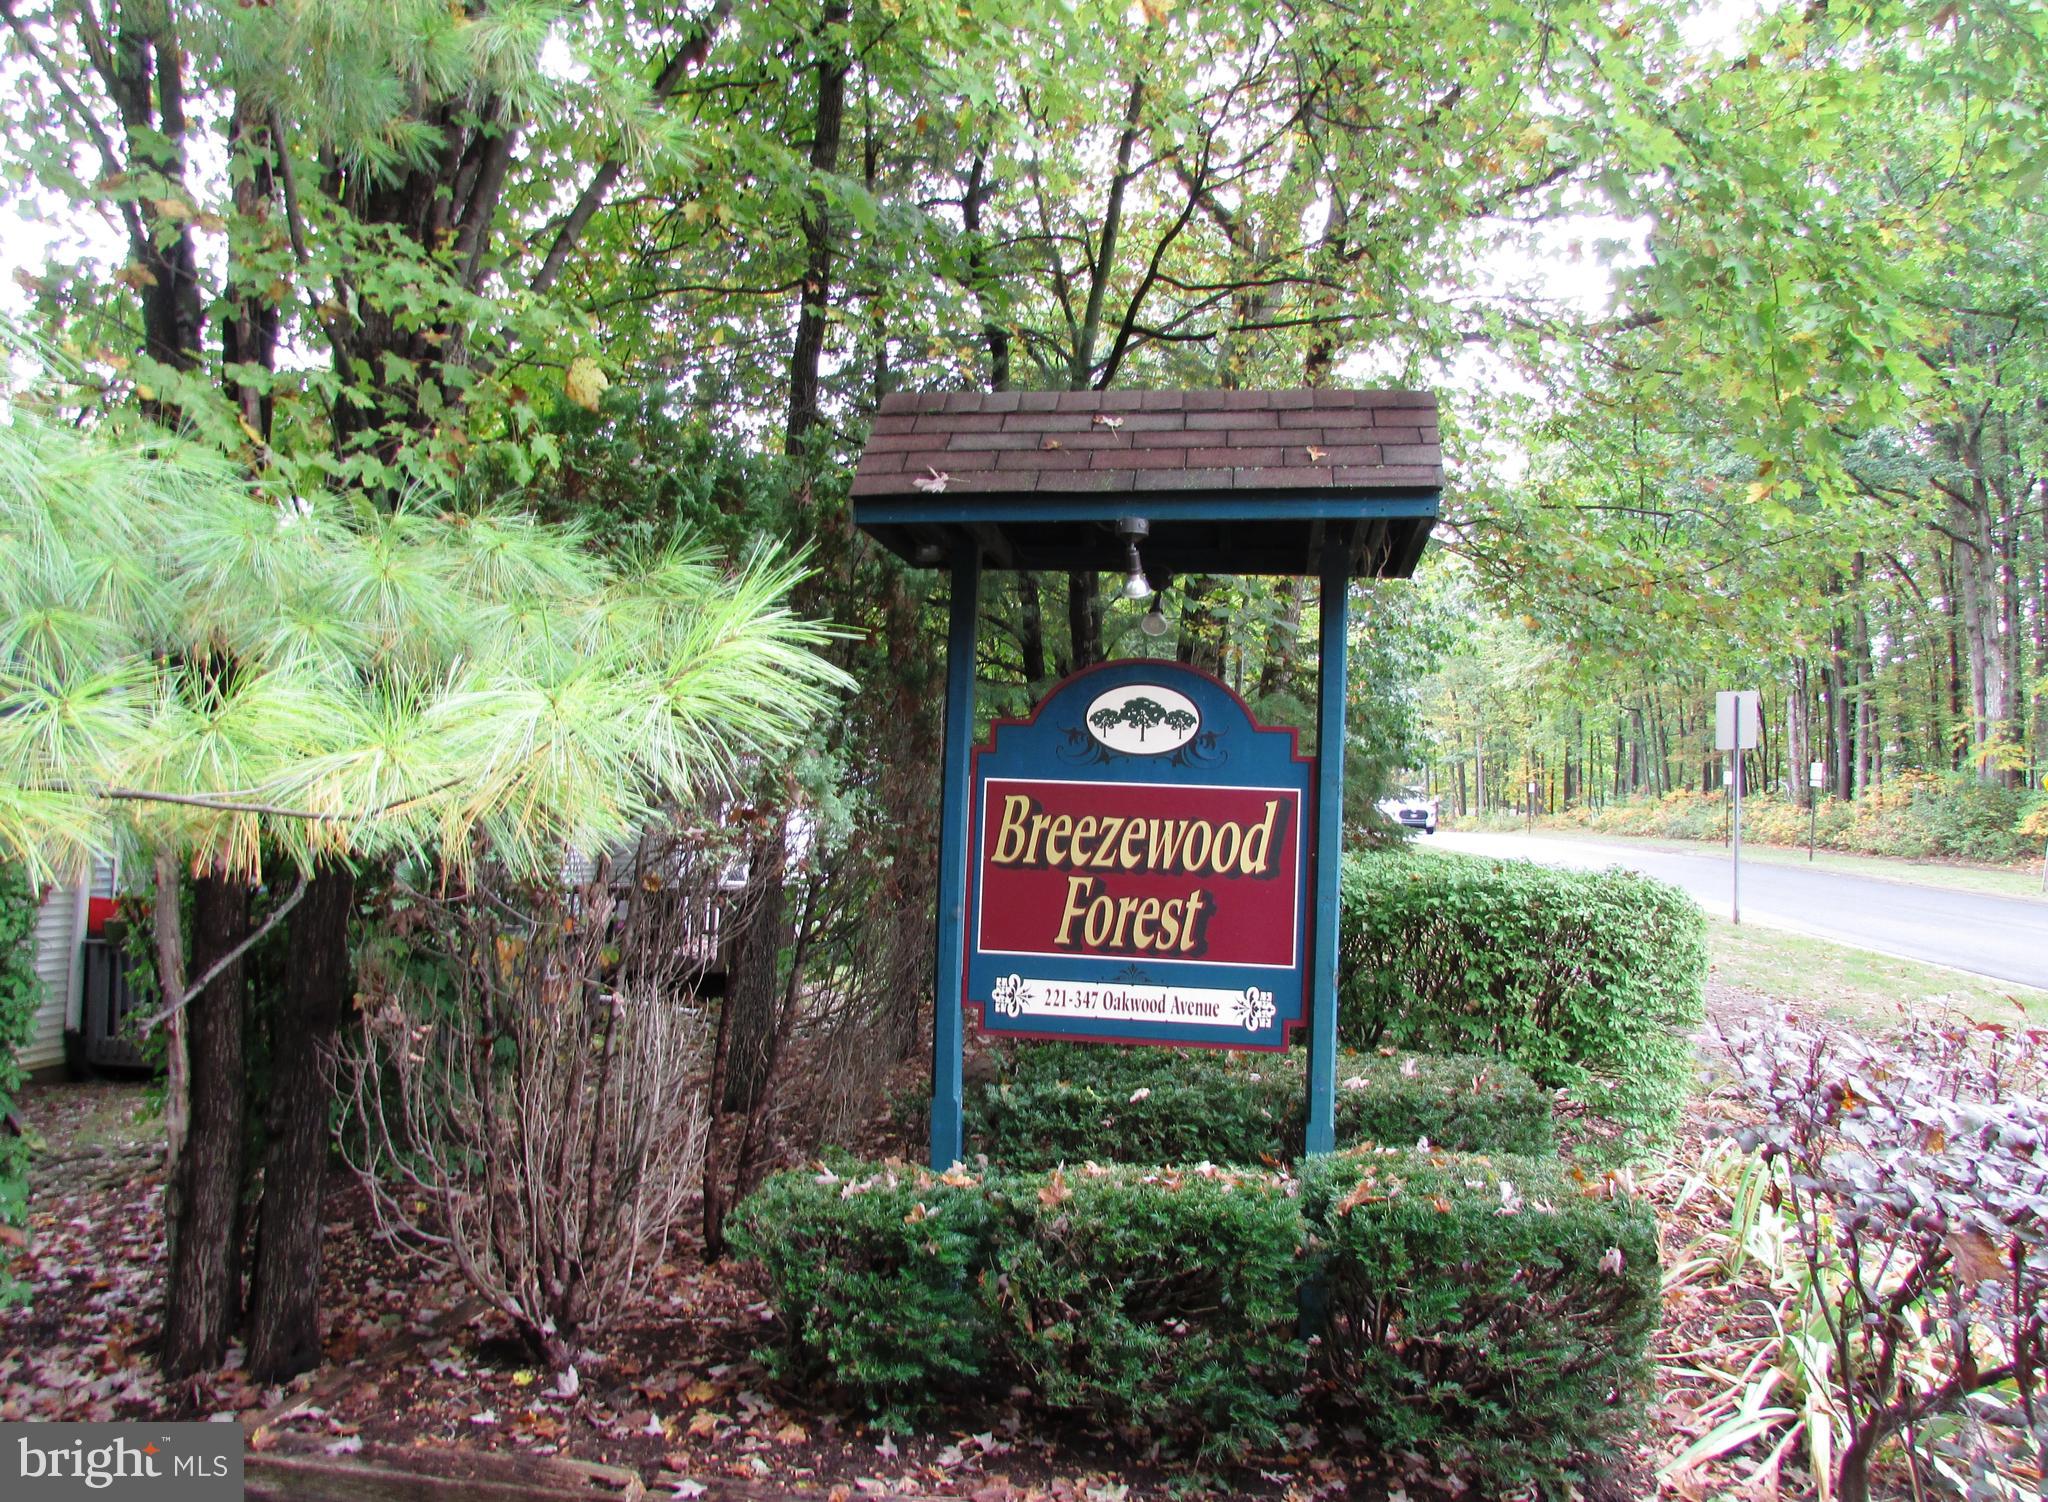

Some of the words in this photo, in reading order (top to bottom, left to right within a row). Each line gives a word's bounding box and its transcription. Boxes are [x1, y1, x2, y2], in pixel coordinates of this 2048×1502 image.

[991, 795, 1278, 874] Breezewood
[1054, 876, 1203, 951] Forest
[1044, 988, 1098, 1009] 221-347
[1103, 991, 1167, 1015] Oakwood
[1170, 996, 1220, 1018] Avenue
